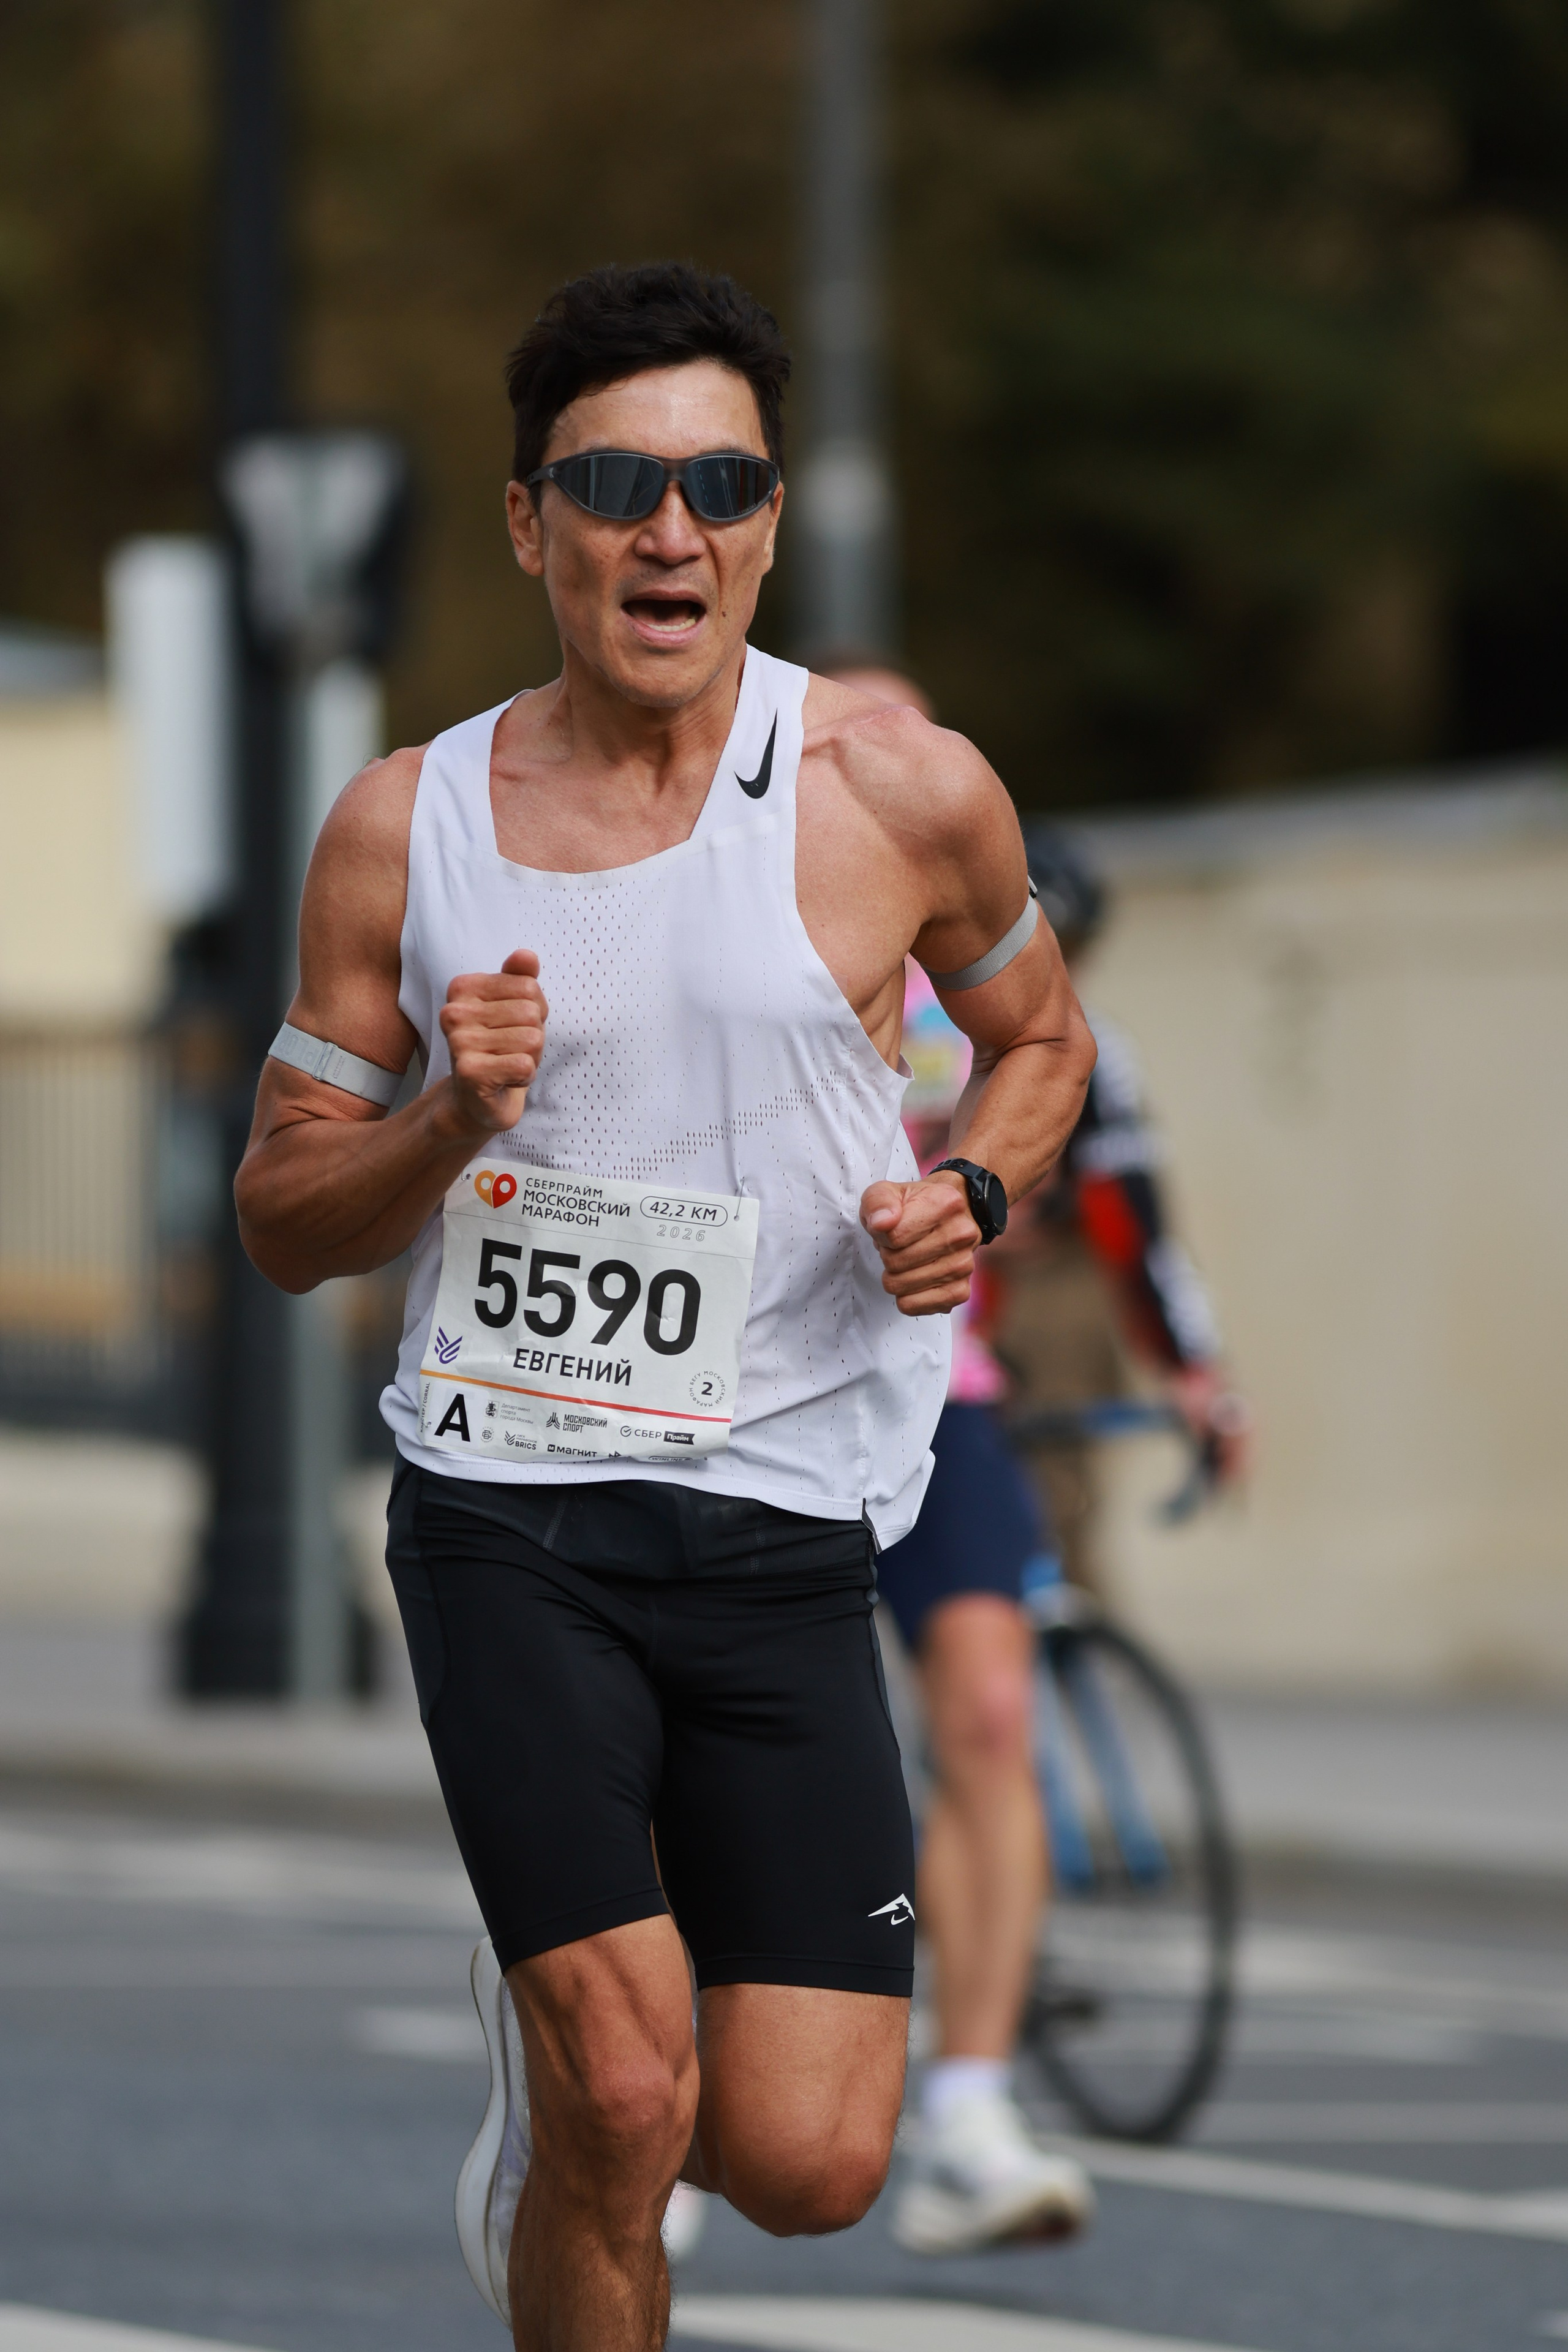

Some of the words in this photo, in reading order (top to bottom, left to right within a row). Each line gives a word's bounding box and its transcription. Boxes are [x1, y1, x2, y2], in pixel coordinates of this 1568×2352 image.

[526, 1177, 603, 1198] СБЕРПРАЙМ
[523, 1189, 630, 1217] МОСКОВСКИЙ
[649, 1201, 685, 1218] 42,2
[691, 1206, 717, 1221] КМ
[521, 1204, 600, 1227] МАРАФОН
[656, 1224, 706, 1242] 2026
[474, 1237, 701, 1357] 5590
[512, 1348, 633, 1387] ЕВГЕНИЙ
[690, 1373, 701, 1385] БЕГУ
[701, 1381, 713, 1396] 2
[704, 1371, 726, 1404] МОСКОВСКИЙ
[689, 1387, 713, 1407] МАРАФОН
[434, 1393, 470, 1442] A
[501, 1403, 530, 1412] Департамент
[562, 1423, 583, 1433] СПОРТ
[564, 1414, 608, 1428] МОСКОВСКИЙ
[515, 1441, 537, 1450] BRICS
[634, 1429, 662, 1439] СБЕР
[667, 1433, 689, 1442] Прайм
